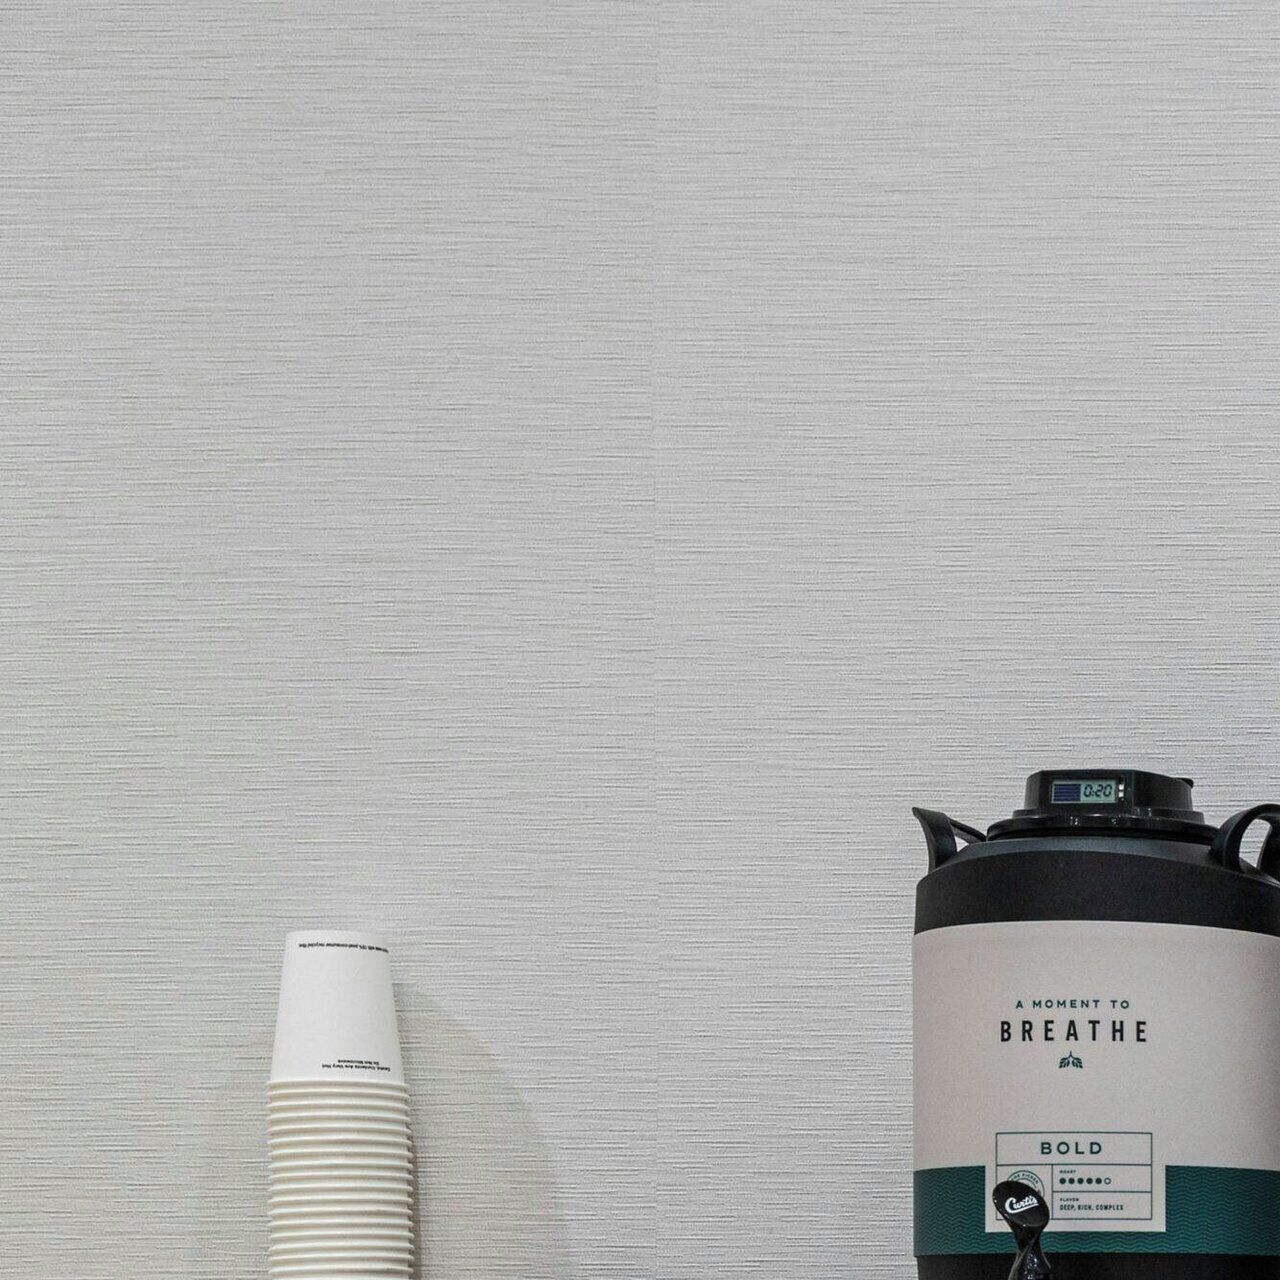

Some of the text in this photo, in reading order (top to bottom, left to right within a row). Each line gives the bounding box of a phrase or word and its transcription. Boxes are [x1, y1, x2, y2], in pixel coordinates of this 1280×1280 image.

[1083, 783, 1113, 798] 0:20
[1015, 1000, 1130, 1009] A MOMENT TO
[1000, 1019, 1147, 1042] BREATHE
[1041, 1141, 1102, 1155] BOLD
[1004, 1195, 1039, 1214] Curtis
